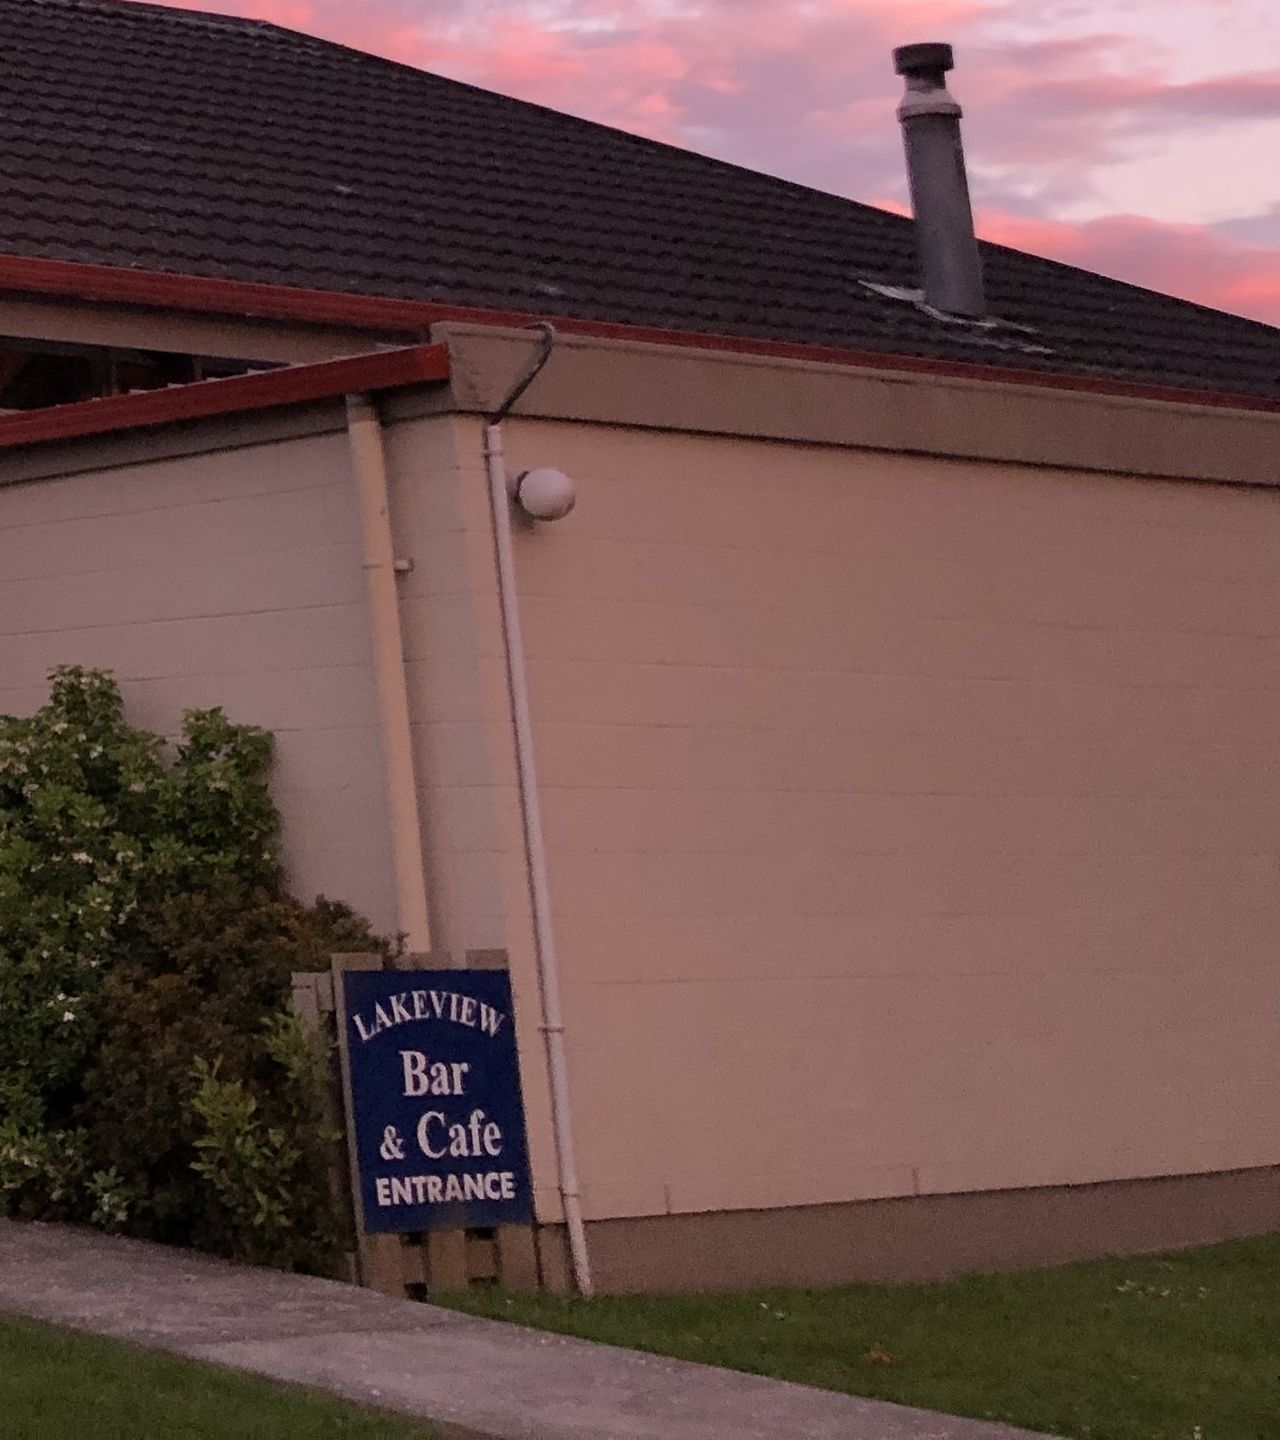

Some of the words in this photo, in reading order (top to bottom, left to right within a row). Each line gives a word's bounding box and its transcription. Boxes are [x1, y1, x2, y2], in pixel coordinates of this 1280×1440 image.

[352, 989, 506, 1042] LAKEVIEW
[398, 1049, 470, 1097] Bar
[379, 1124, 406, 1161] &
[416, 1108, 504, 1160] Cafe
[374, 1171, 516, 1207] ENTRANCE
